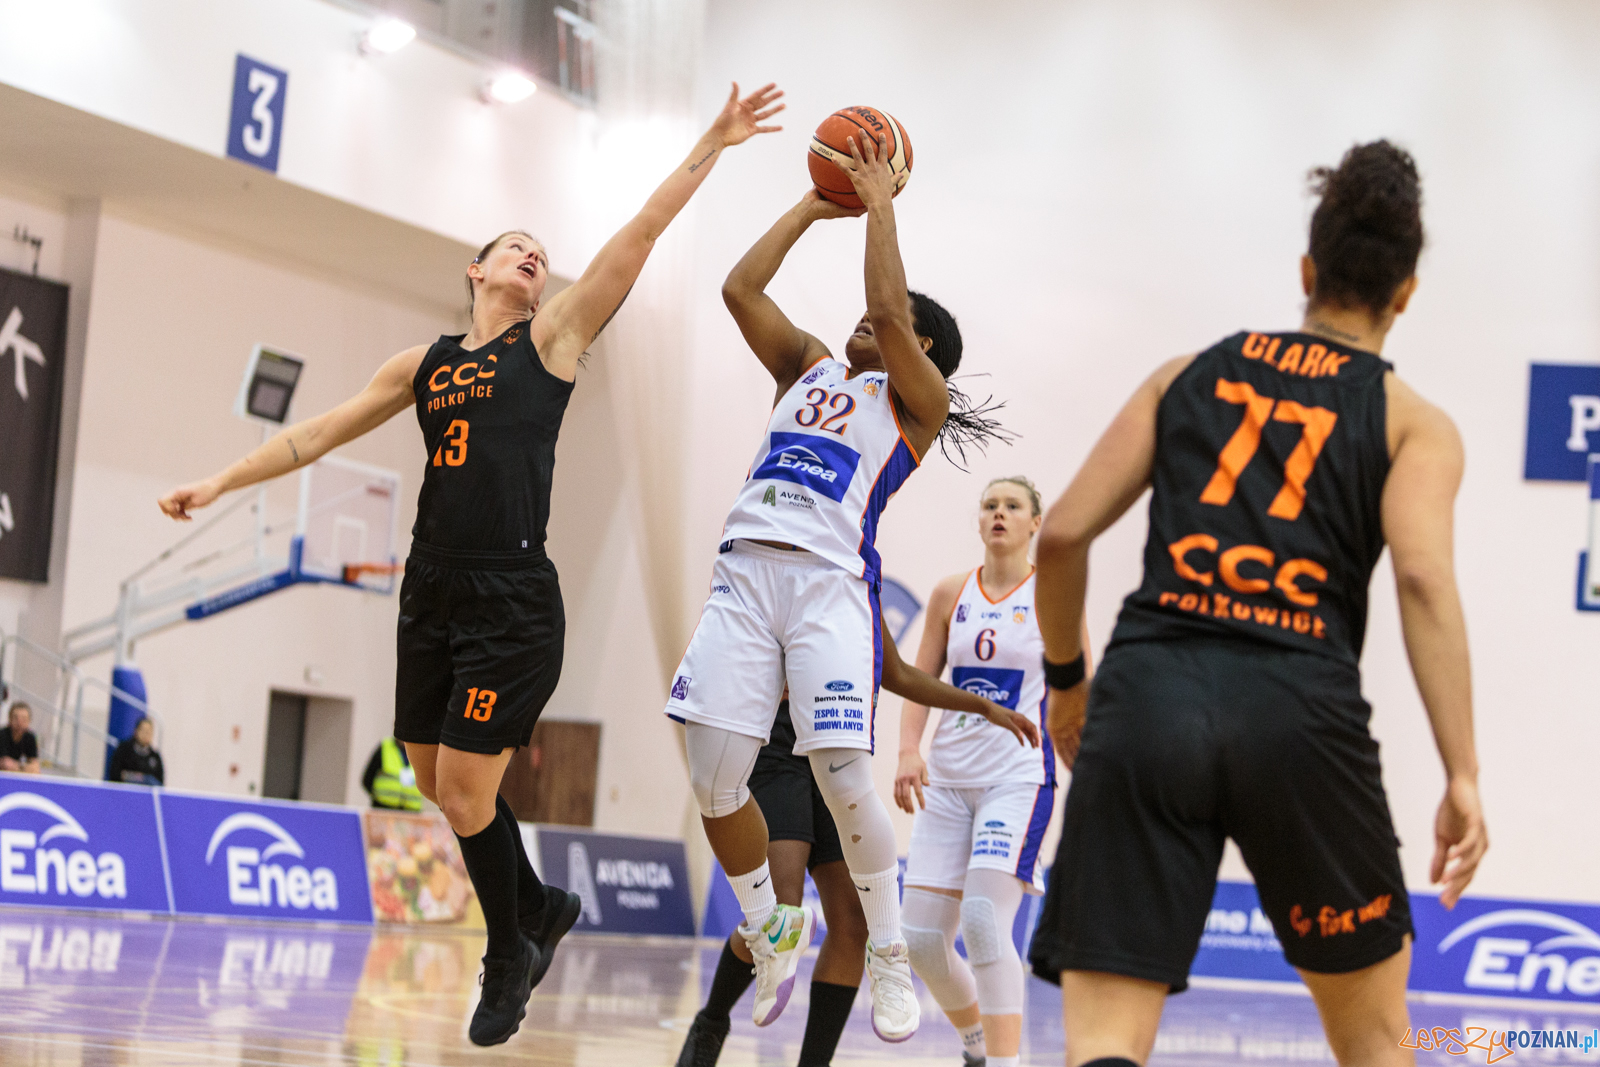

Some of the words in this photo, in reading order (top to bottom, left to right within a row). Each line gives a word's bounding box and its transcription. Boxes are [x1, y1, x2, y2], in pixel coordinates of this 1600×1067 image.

[242, 67, 279, 157] 3
[1241, 332, 1351, 377] CLARK
[428, 354, 498, 392] CCC
[427, 385, 493, 414] POLKOICE
[794, 387, 856, 436] 32
[1200, 377, 1338, 521] 77
[776, 452, 838, 483] Enea
[780, 491, 817, 506] AVENID
[1169, 533, 1328, 607] CCC
[974, 628, 997, 661] 6
[463, 687, 498, 722] 13
[814, 707, 840, 719] ZESPÓŁ
[844, 708, 863, 720] SZKÓŁ
[838, 694, 863, 703] Motors
[814, 720, 864, 732] BUDOWLANYCH
[0, 829, 127, 899] Enea
[226, 846, 339, 911] Enea
